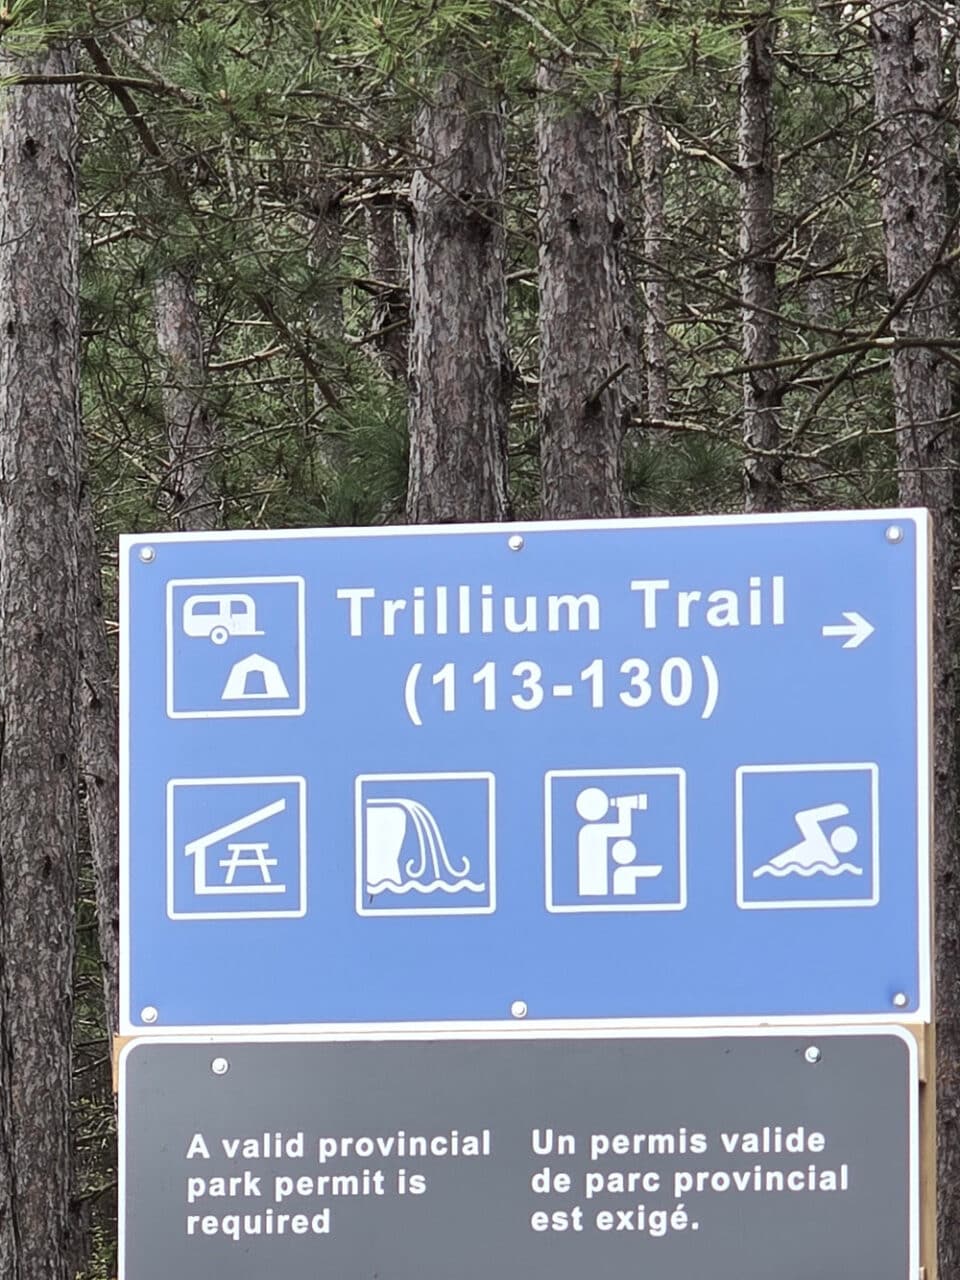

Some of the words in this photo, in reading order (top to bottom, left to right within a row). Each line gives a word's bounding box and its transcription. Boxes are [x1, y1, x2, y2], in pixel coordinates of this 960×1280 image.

[337, 585, 599, 636] Trillium
[631, 576, 784, 628] Trail
[405, 656, 718, 725] (113-130)
[187, 1134, 210, 1158] A
[222, 1132, 303, 1158] valid
[319, 1130, 490, 1163] provincial
[533, 1129, 575, 1154] Un
[592, 1128, 707, 1160] permis
[721, 1127, 825, 1152] valide
[188, 1171, 261, 1203] park
[276, 1169, 384, 1202] permit
[399, 1169, 426, 1194] is
[532, 1167, 571, 1193] de
[586, 1172, 659, 1198] parc
[675, 1164, 848, 1197] provincial
[188, 1208, 330, 1240] required
[531, 1206, 583, 1231] est
[596, 1204, 698, 1236] exigé.
